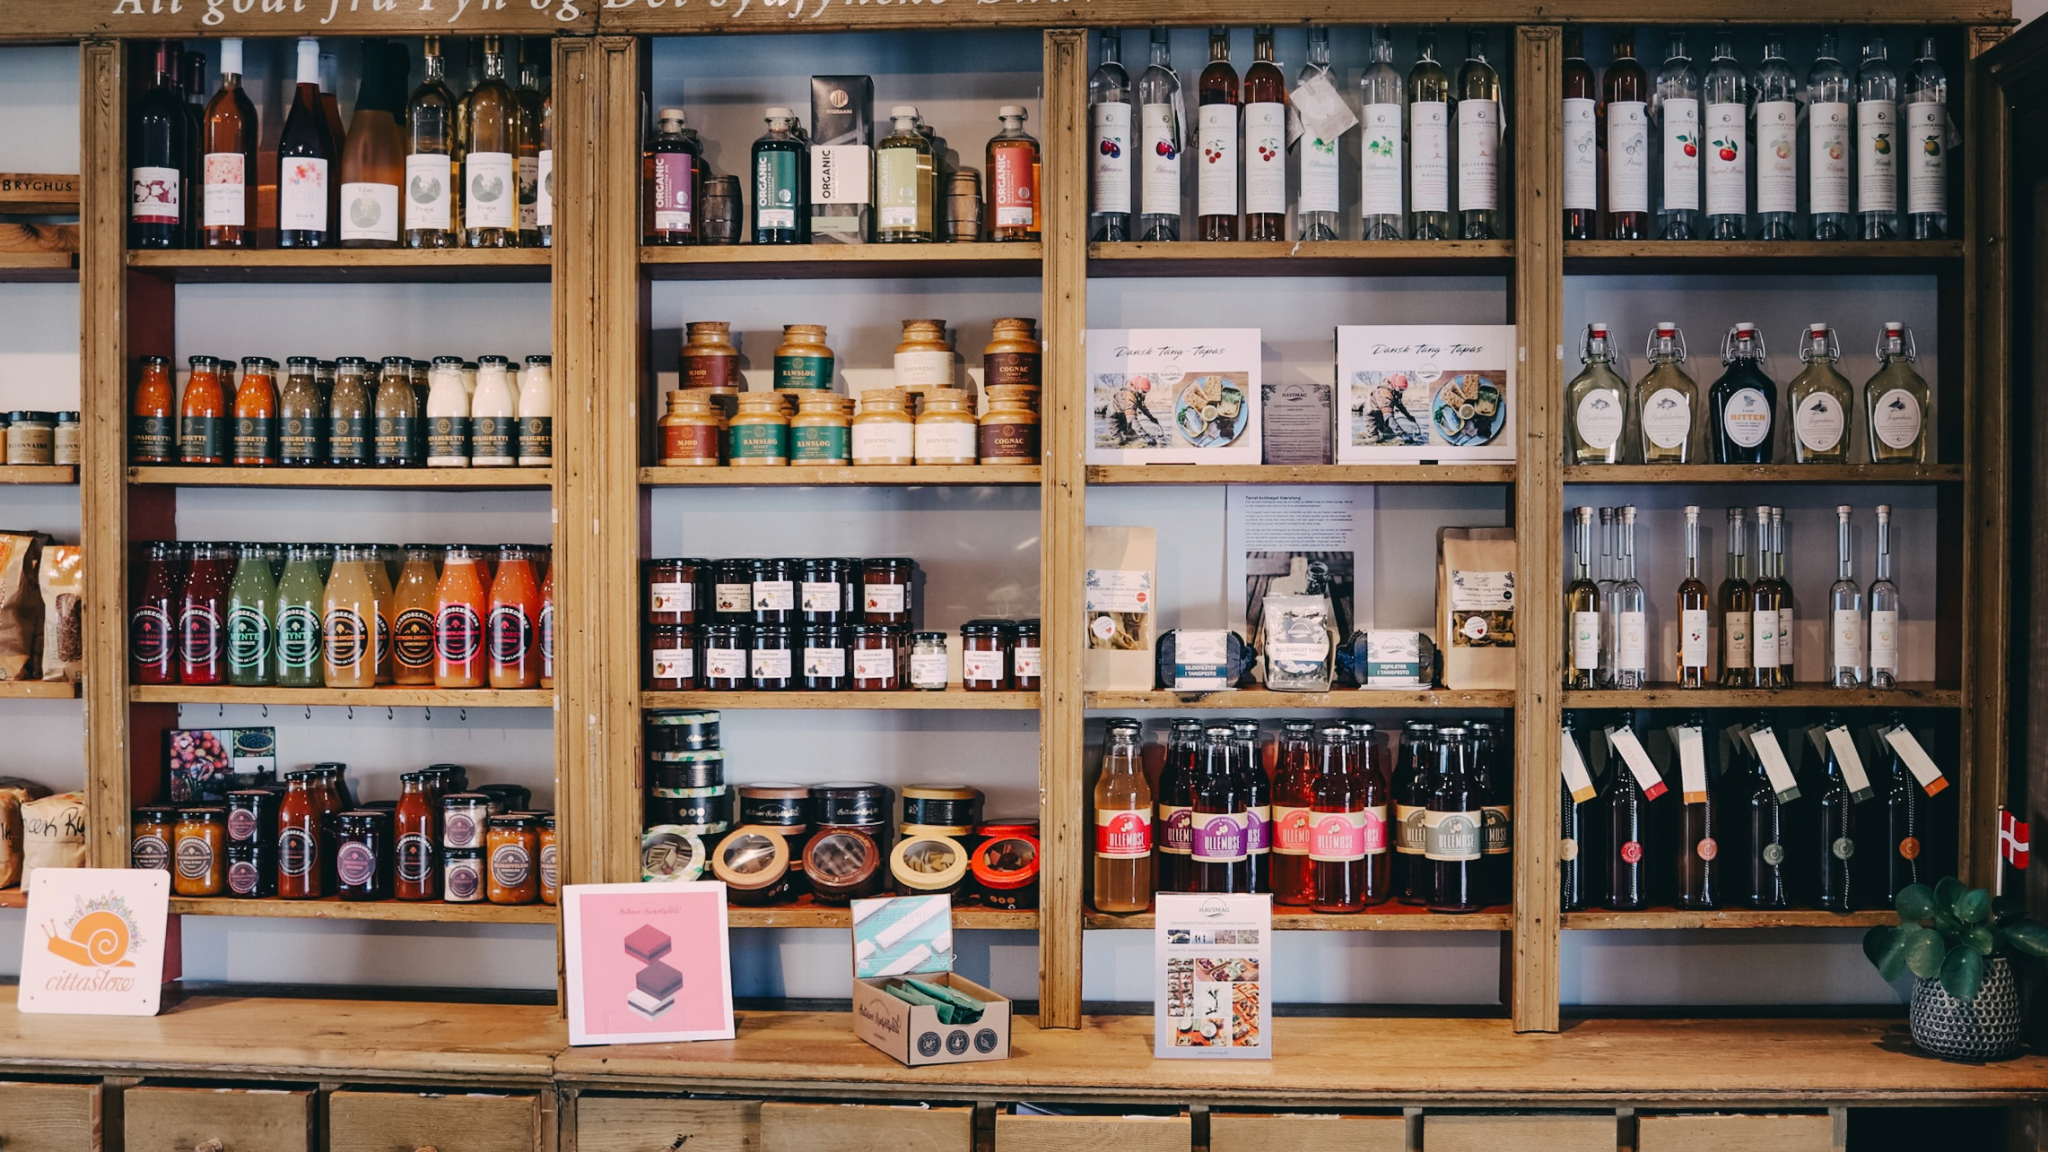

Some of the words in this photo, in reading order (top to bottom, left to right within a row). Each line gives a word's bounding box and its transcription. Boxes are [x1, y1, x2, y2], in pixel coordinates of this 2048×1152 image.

[2, 179, 72, 192] BRYGHUS
[656, 158, 664, 208] ORGANIC
[758, 156, 768, 207] ORGANIC
[998, 154, 1006, 204] ORGANIC
[1114, 346, 1152, 358] Dansk
[1371, 344, 1410, 355] Dansk
[1108, 832, 1144, 846] ULLEMOSE
[1168, 828, 1192, 842] ULLEM
[1282, 828, 1310, 843] ULLEMO
[1318, 834, 1353, 848] ULLEMOSE
[1406, 828, 1425, 842] ULLE
[1439, 834, 1474, 848] ULLEMOSE
[1204, 836, 1240, 850] ULLEMOSE
[44, 969, 135, 992] cittaslow
